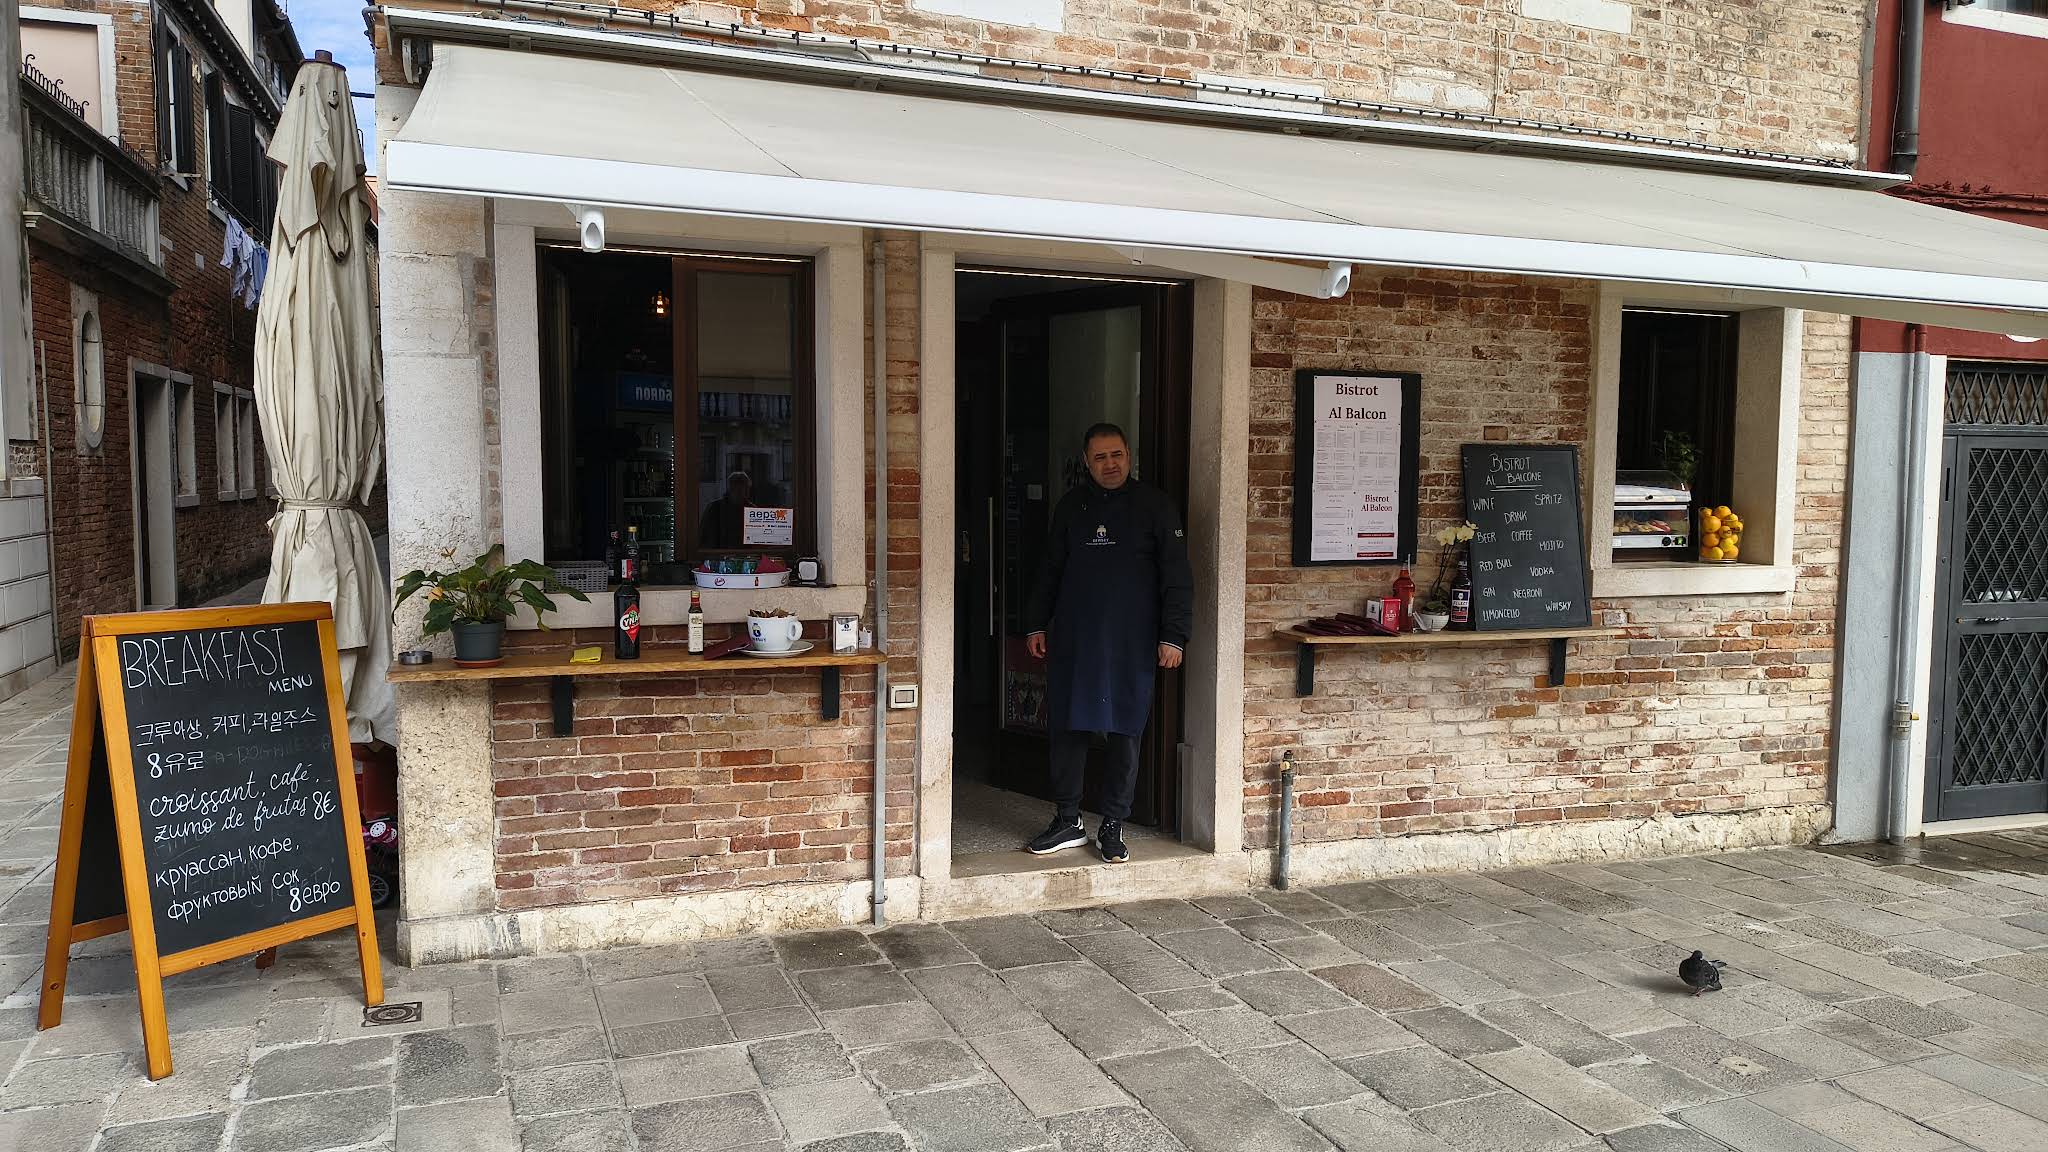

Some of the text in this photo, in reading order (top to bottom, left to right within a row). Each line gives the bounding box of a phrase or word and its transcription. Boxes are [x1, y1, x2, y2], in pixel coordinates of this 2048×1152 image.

[1335, 383, 1379, 396] Bistrot
[1328, 407, 1387, 420] Al Balcon
[1489, 453, 1531, 472] BISTROT
[1485, 472, 1542, 486] AL BALCONE
[1365, 494, 1390, 503] Bistrot
[1472, 497, 1495, 511] WINE
[1534, 493, 1563, 506] SPRITZ
[1361, 503, 1369, 512] Al
[1369, 503, 1393, 512] Balcon
[1504, 510, 1528, 525] DRINK
[1477, 531, 1497, 544] BEER
[1511, 529, 1533, 542] COFFEE
[1539, 540, 1564, 552] MOJITO
[1479, 560, 1494, 572] RED
[1496, 558, 1513, 569] BULL
[1529, 566, 1555, 577] VODKA
[1482, 586, 1496, 597] GIN
[1512, 587, 1543, 599] NEGRONI
[1545, 600, 1572, 612] WHISKY
[1482, 608, 1521, 621] LIMONCELLO
[122, 628, 286, 688] BREAKFAST
[268, 673, 313, 696] MENU
[153, 790, 337, 843] zumo de frutas 8€
